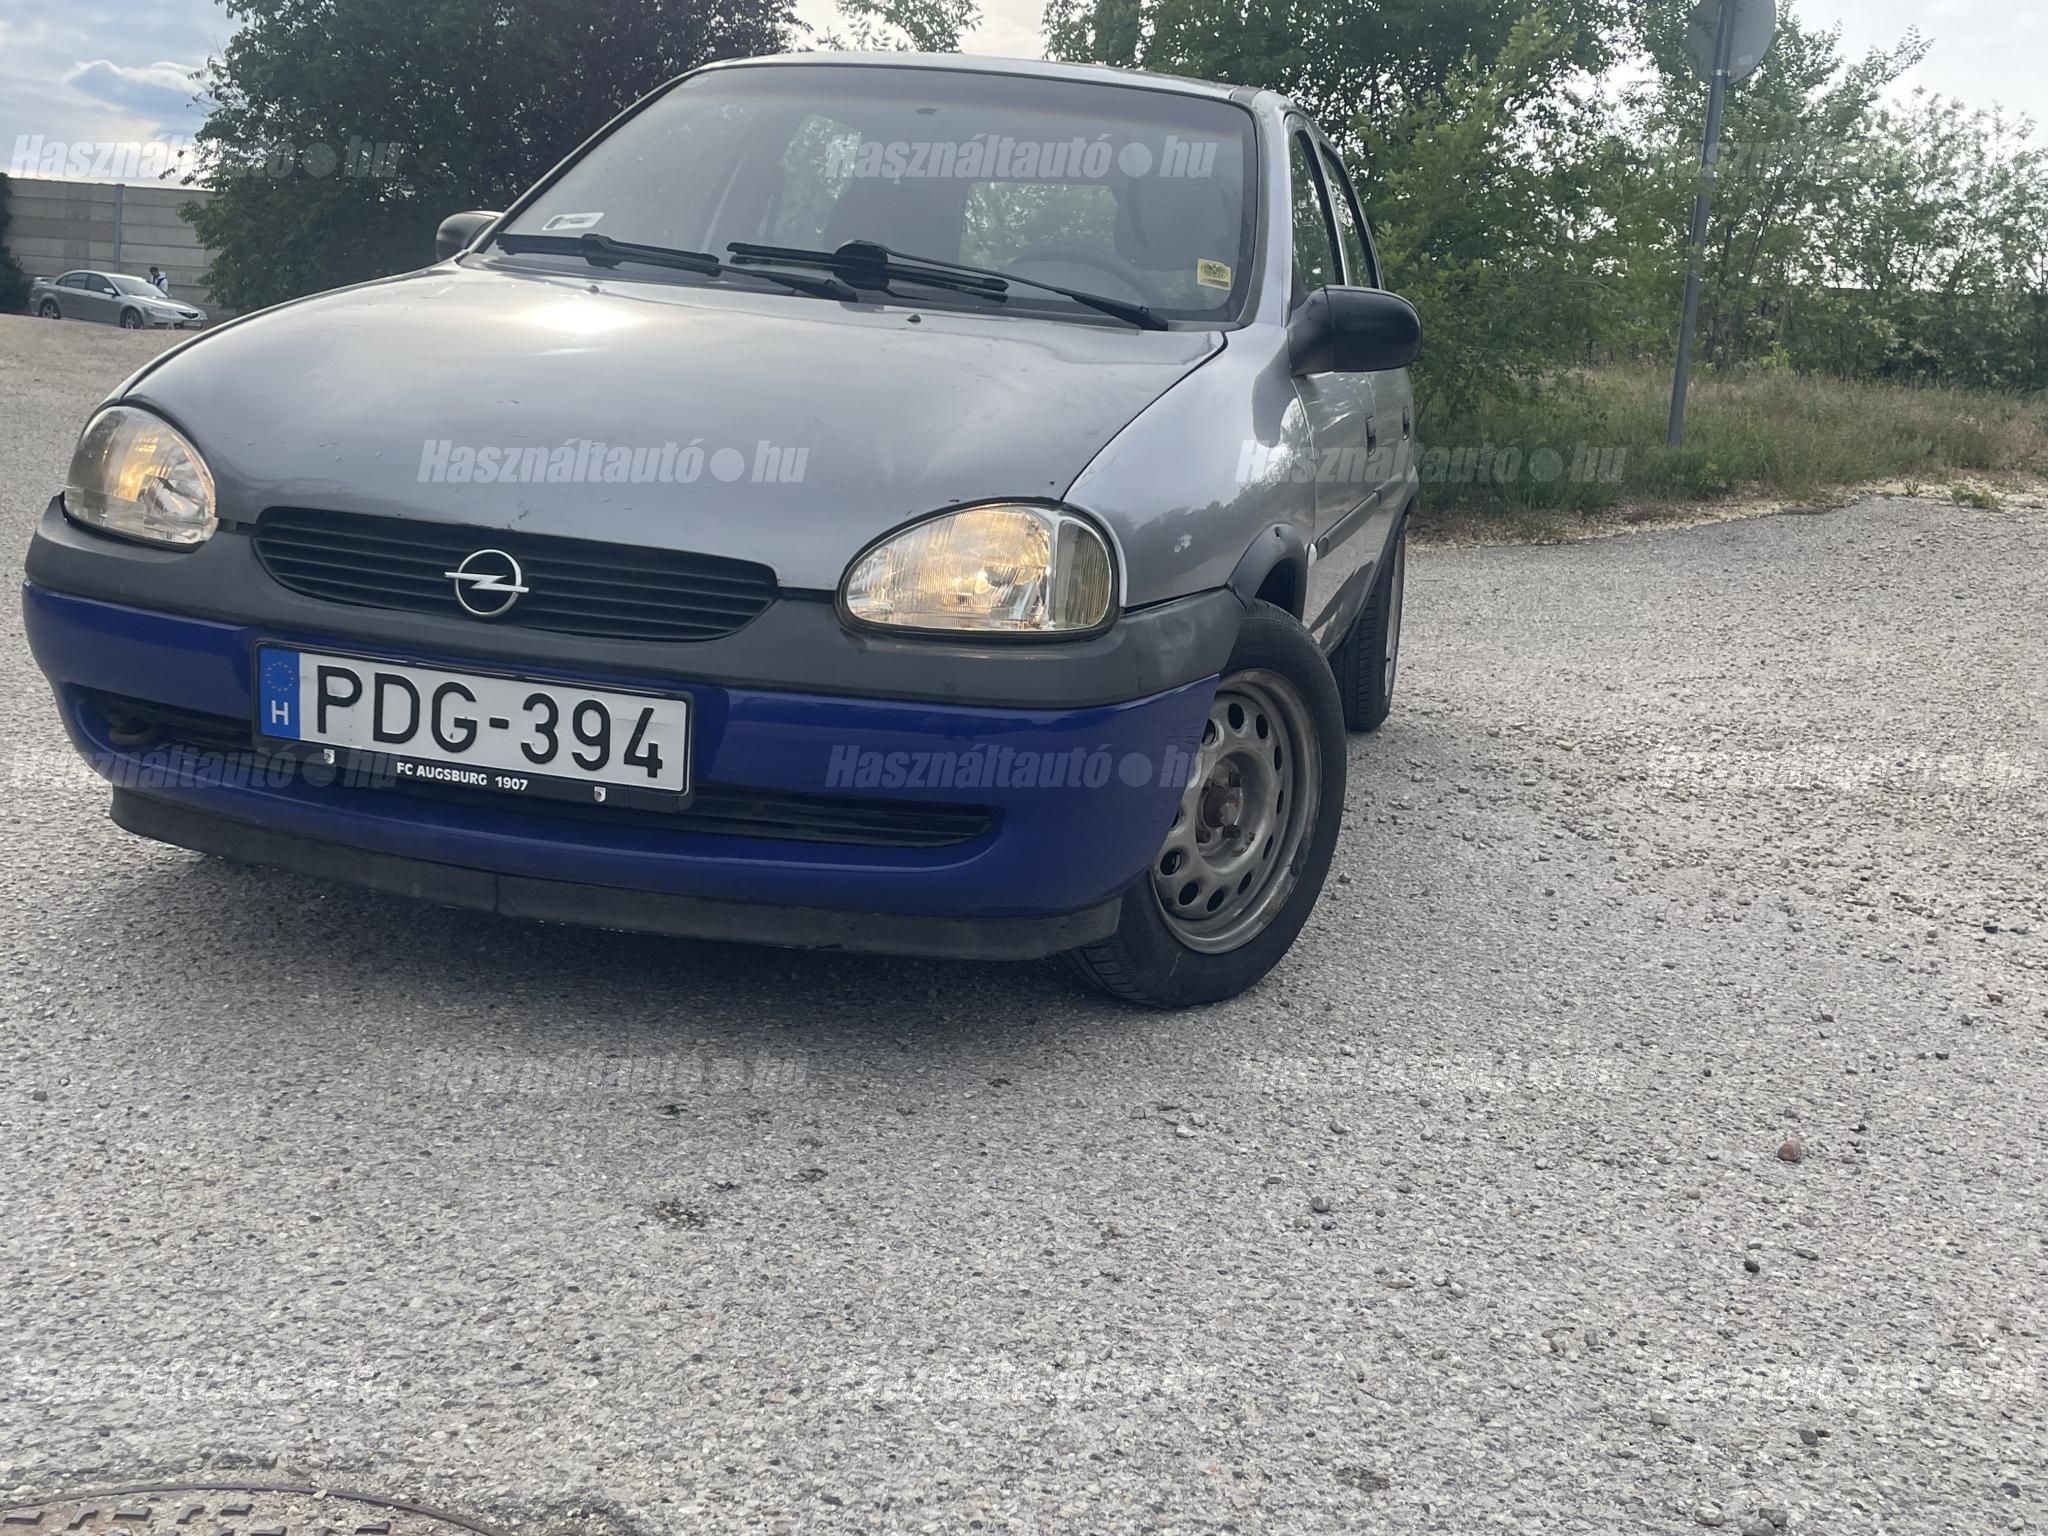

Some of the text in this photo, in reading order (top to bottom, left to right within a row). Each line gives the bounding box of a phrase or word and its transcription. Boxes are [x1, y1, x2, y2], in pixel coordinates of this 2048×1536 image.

[271, 700, 289, 725] H
[317, 665, 663, 778] PDG-394
[396, 762, 528, 791] FC AUGSBURG 1907
